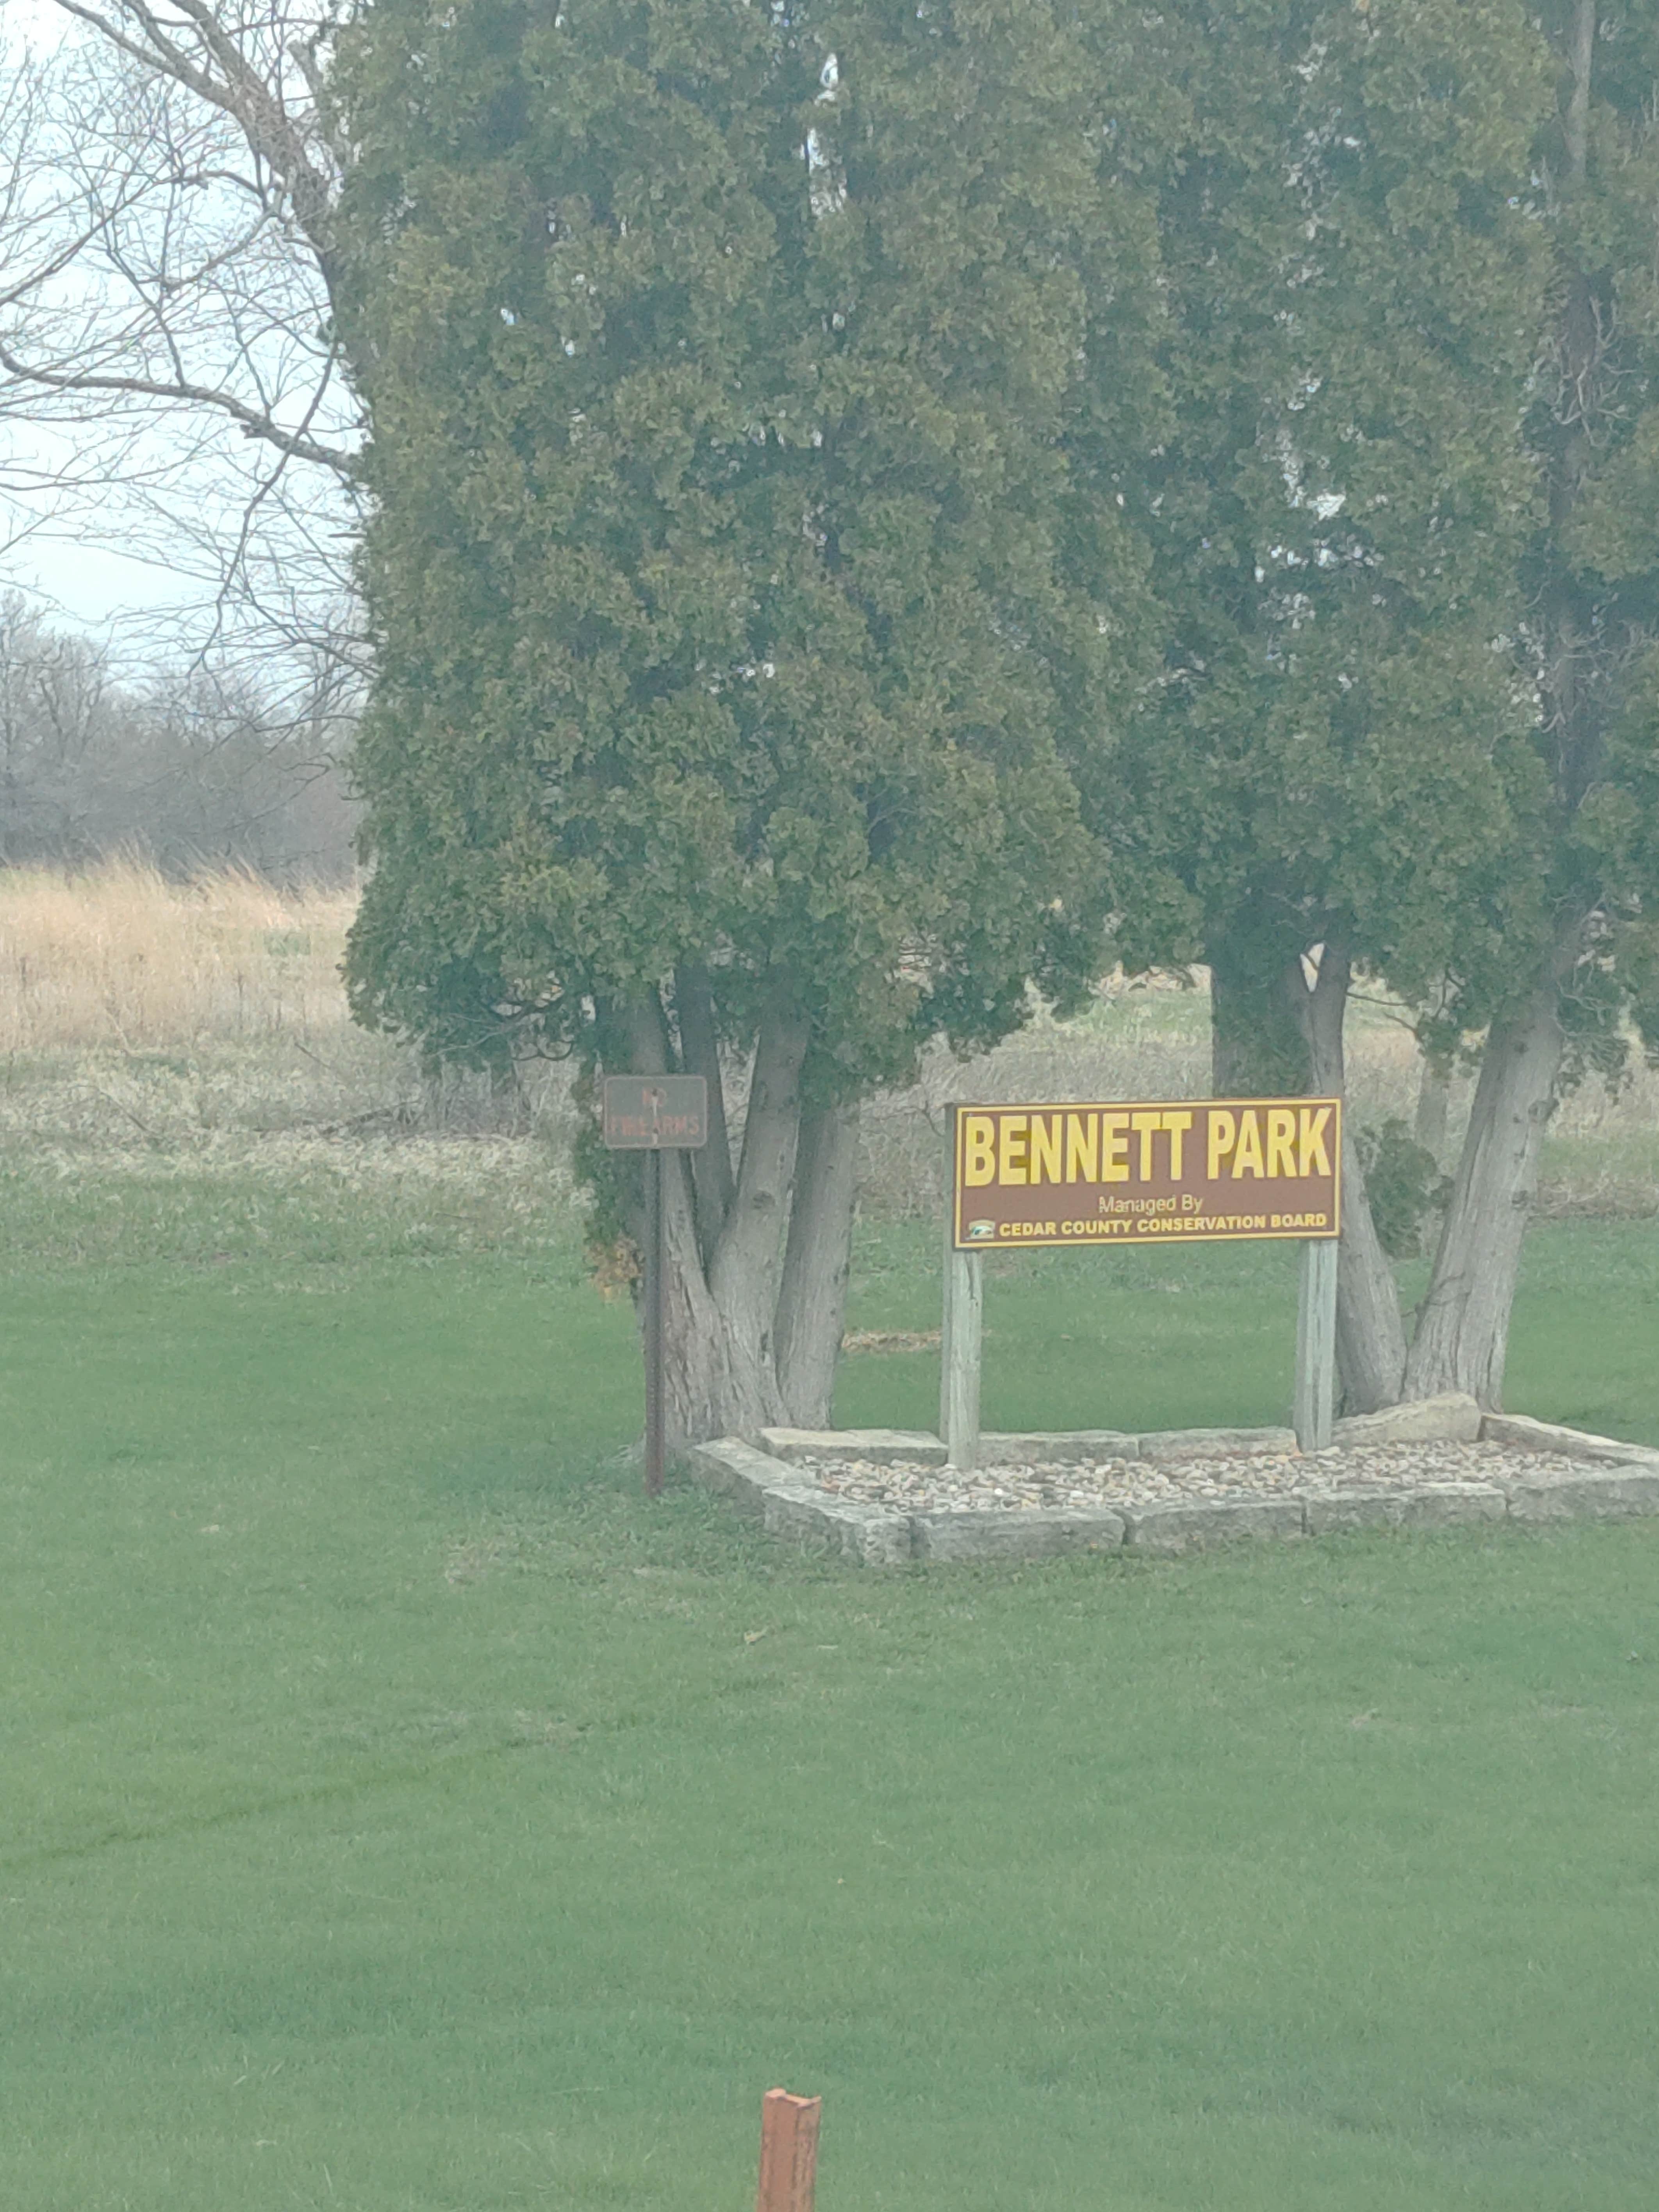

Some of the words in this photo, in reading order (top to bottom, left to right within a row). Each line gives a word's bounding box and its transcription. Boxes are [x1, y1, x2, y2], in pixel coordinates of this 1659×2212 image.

[965, 1111, 1192, 1186] BENNETT
[1207, 1108, 1332, 1180] PARK
[1099, 1195, 1176, 1216] Managed
[1181, 1194, 1204, 1214] By
[999, 1221, 1057, 1237] CEDAR
[1061, 1219, 1133, 1235] COUNTY
[1137, 1215, 1266, 1233] CONSERVATION
[1271, 1213, 1327, 1228] BOARD
